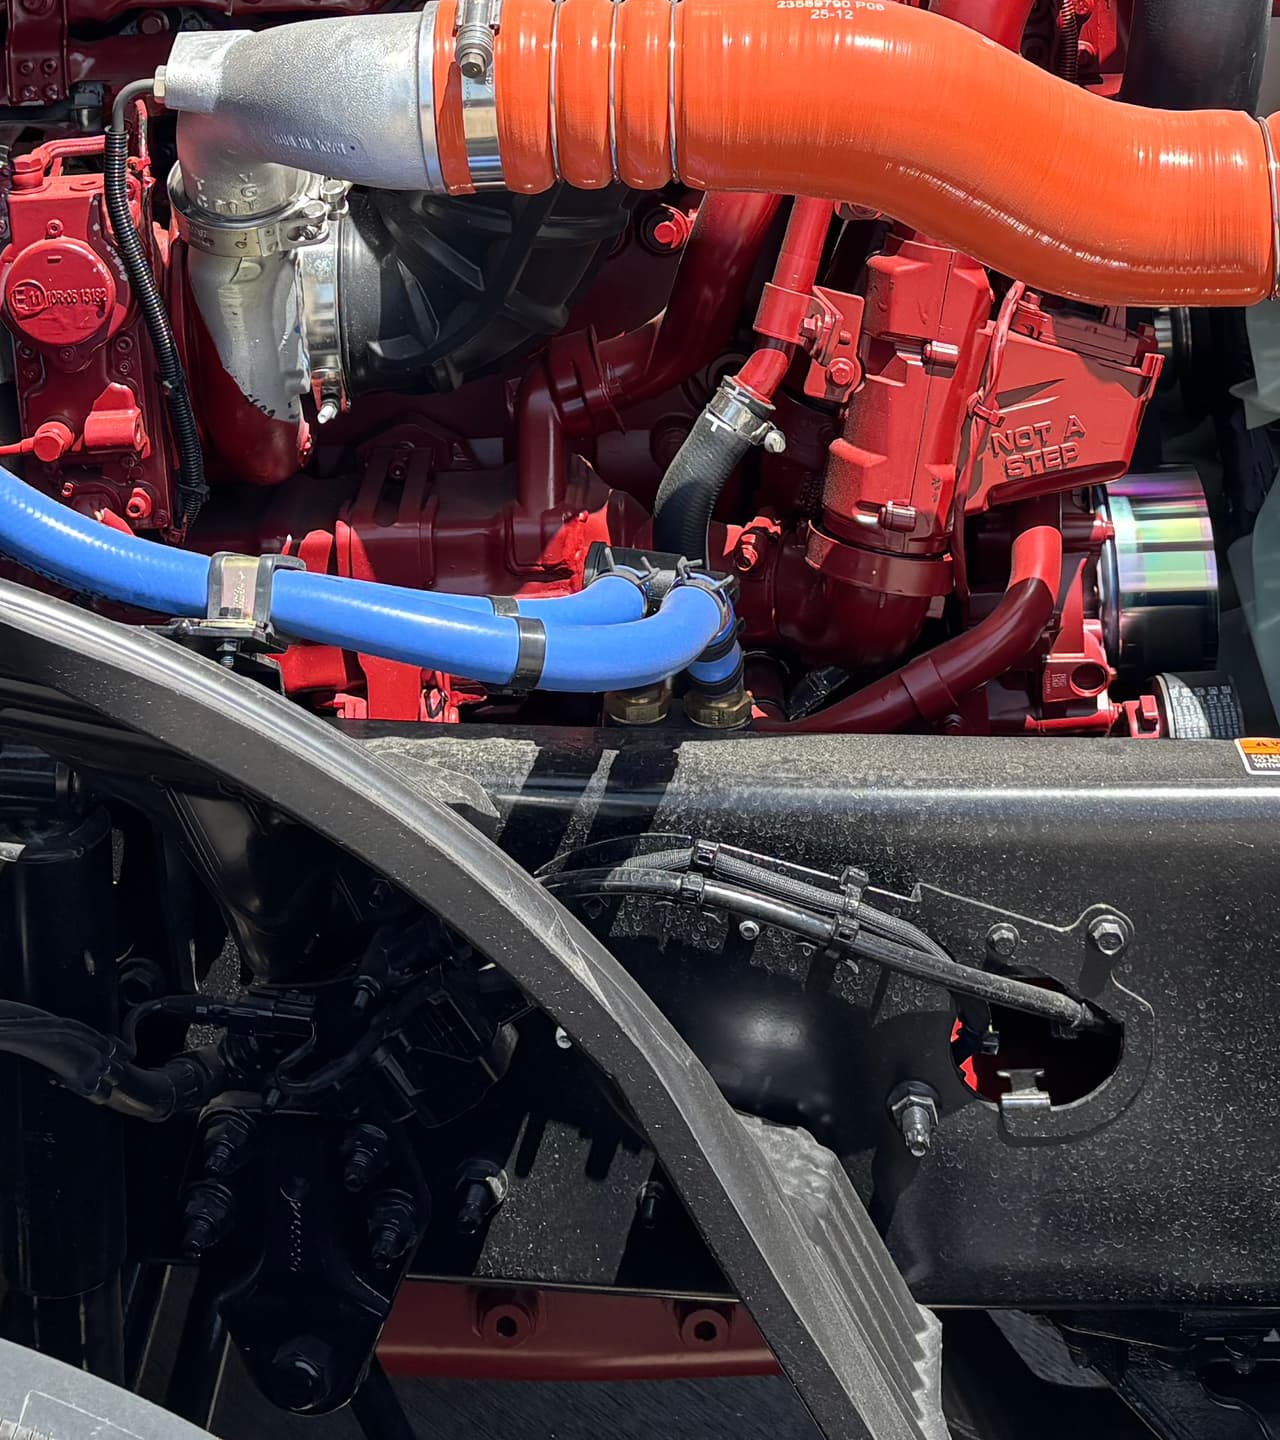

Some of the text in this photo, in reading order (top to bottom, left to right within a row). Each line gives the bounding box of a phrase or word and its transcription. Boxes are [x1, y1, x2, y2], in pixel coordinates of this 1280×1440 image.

[810, 9, 854, 20] 25-12
[991, 415, 1088, 457] NOT A
[1004, 442, 1081, 479] STEP
